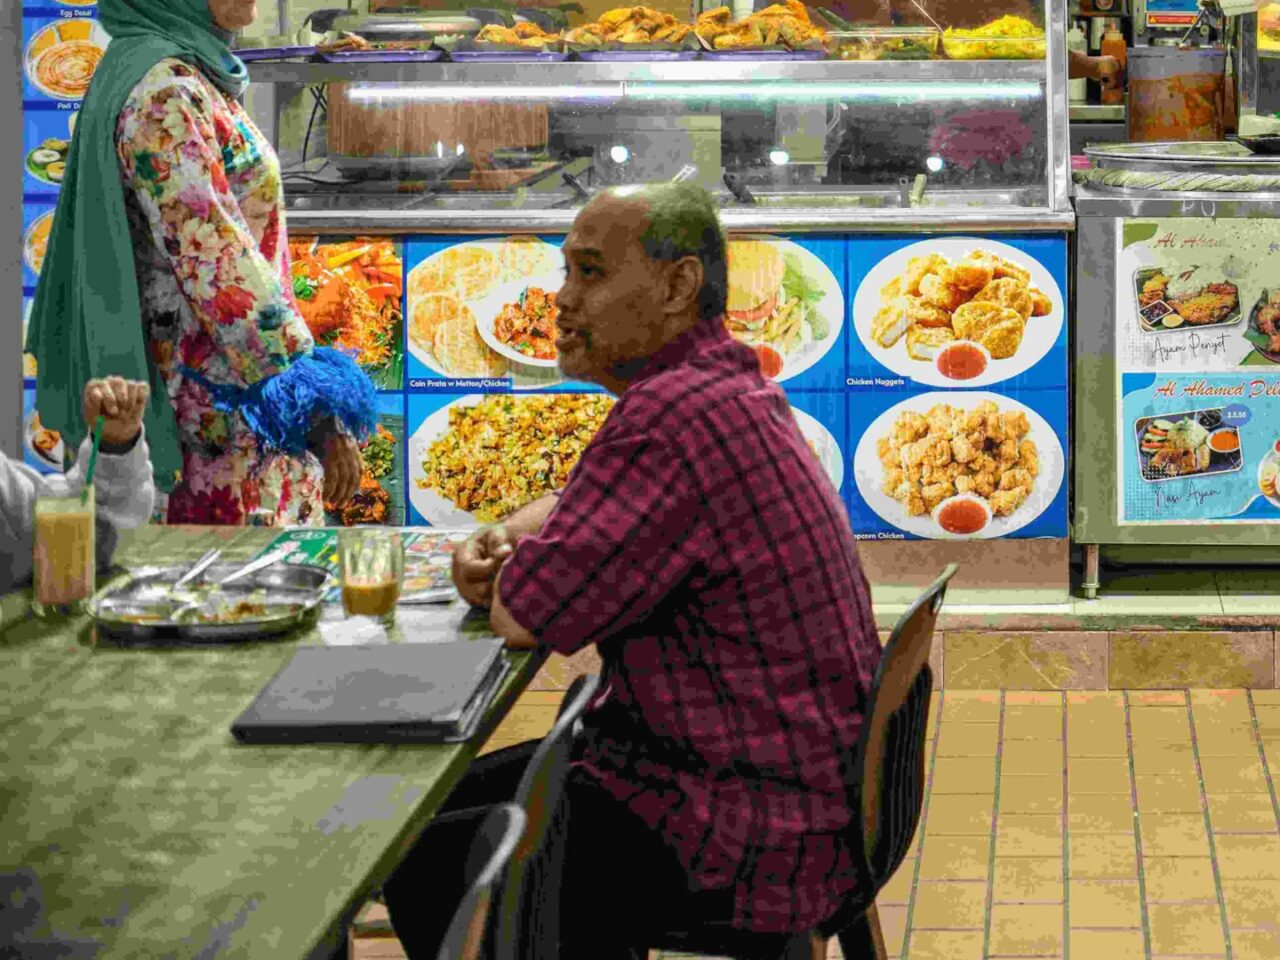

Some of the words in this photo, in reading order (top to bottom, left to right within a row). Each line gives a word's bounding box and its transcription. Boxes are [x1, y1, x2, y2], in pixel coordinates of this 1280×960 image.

[60, 9, 73, 18] Egg
[1152, 336, 1186, 363] Ayam
[1188, 331, 1231, 358] Penyet
[410, 379, 426, 388] Coin
[427, 379, 447, 388] Prata
[456, 379, 510, 389] Mutton/Chicken
[846, 376, 874, 386] Chicken
[875, 376, 904, 388] Nuggets
[1153, 380, 1175, 398] Al
[1180, 381, 1245, 398] Ahamed
[877, 531, 904, 540] Chicken
